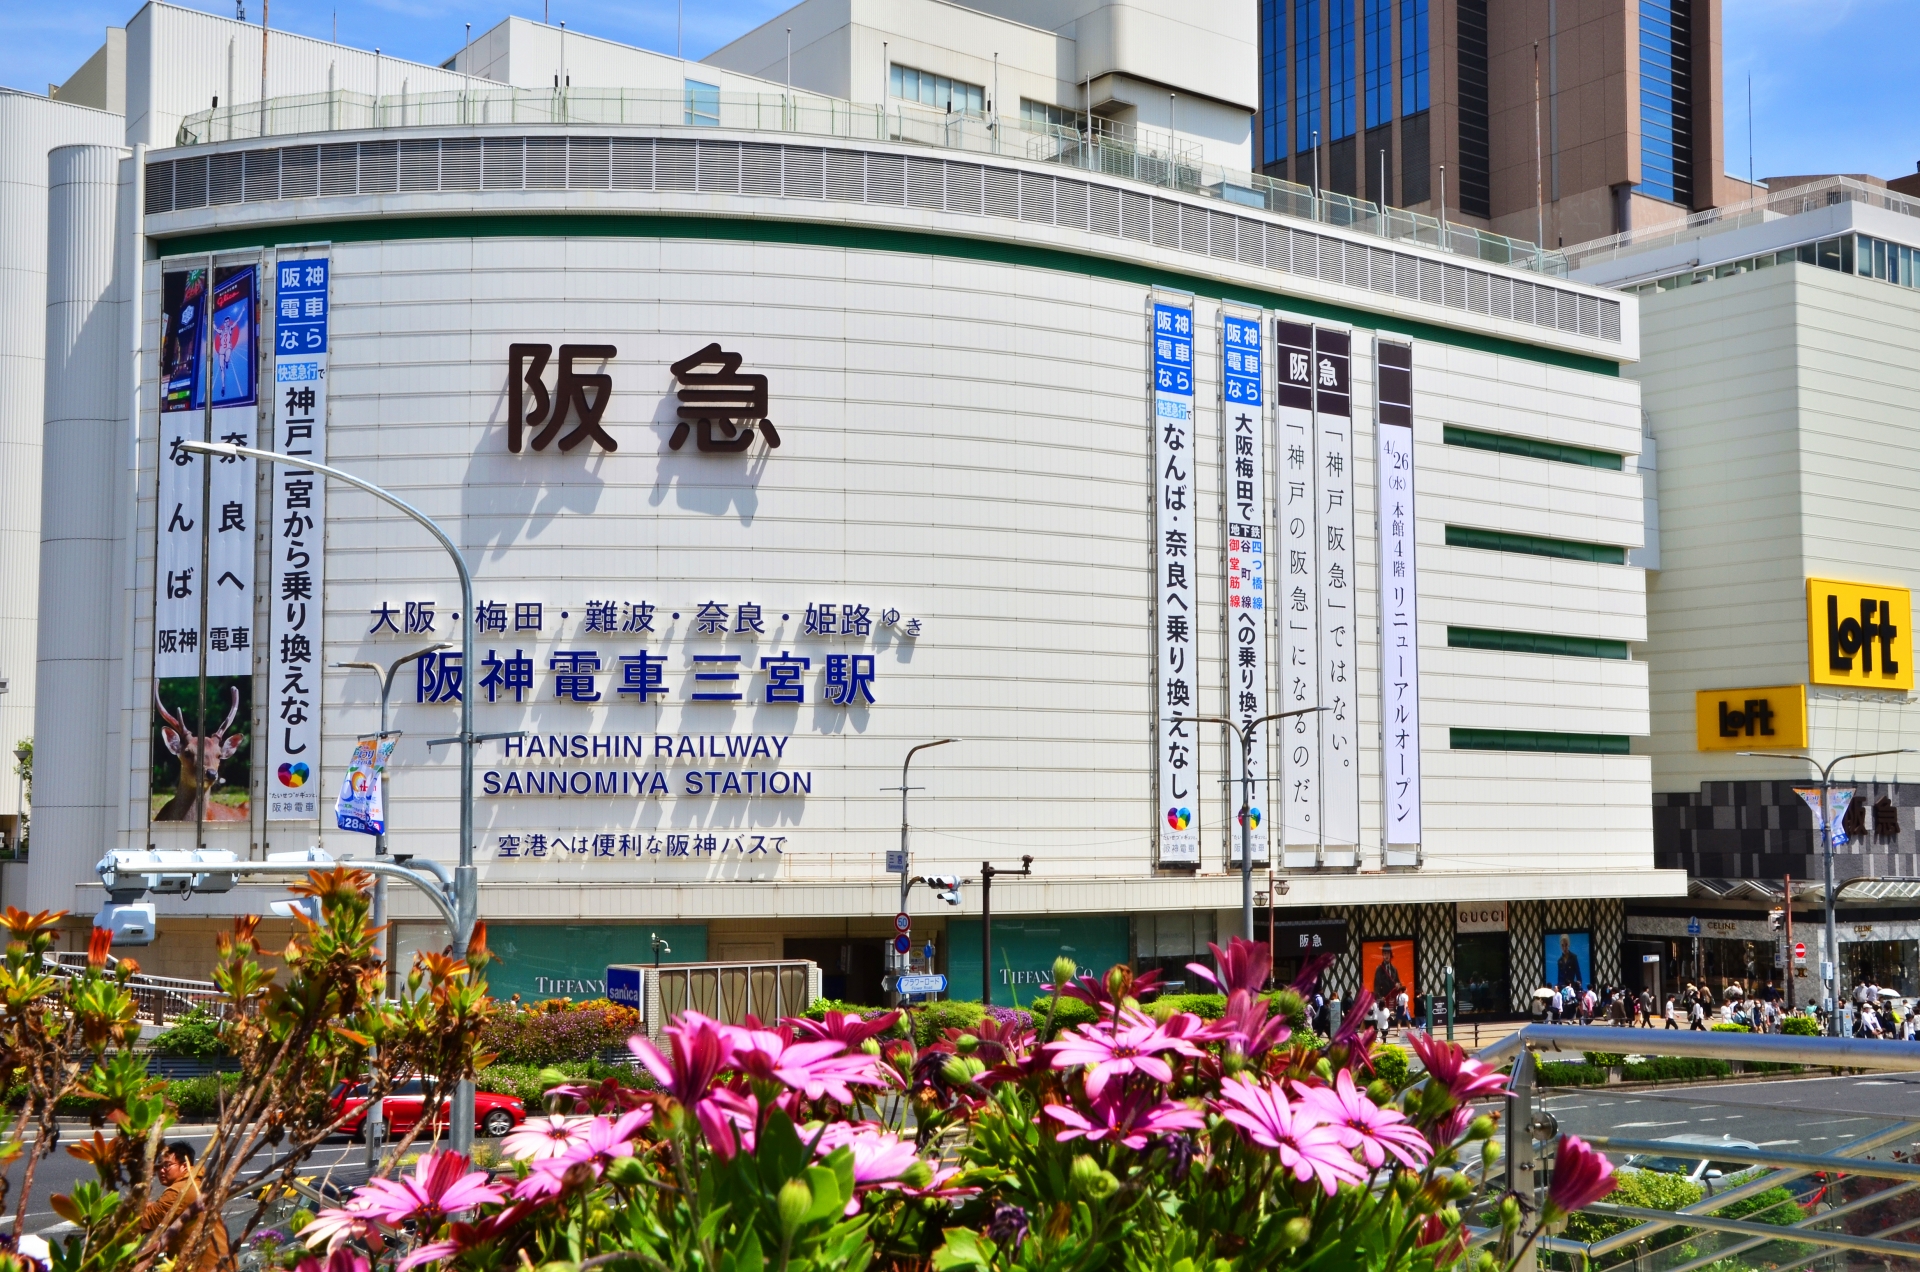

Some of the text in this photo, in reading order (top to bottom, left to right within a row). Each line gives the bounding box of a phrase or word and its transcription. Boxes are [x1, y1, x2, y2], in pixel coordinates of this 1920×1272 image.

[281, 266, 324, 288] 阪神
[281, 297, 324, 319] 電車
[1157, 310, 1189, 333] 阪神
[281, 328, 322, 350] なら
[1227, 322, 1258, 347] 阪神
[1157, 339, 1190, 362] 電車
[277, 363, 325, 382] 快速急行で
[1227, 351, 1259, 374] 電車
[1289, 352, 1338, 387] 阪急
[1158, 368, 1190, 391] なら
[1228, 380, 1259, 402] なら
[508, 342, 781, 454] 阪急
[1235, 413, 1255, 522] 大阪梅田で
[166, 436, 195, 599] なんば
[217, 432, 248, 591] 奈良へ
[1230, 524, 1260, 538] 地下鉄
[280, 386, 316, 755] 神戸三宮から乗り換えなし
[1229, 539, 1240, 608] 御堂筋線
[1241, 540, 1251, 608] 谷町線
[1252, 541, 1262, 610] 四つ橋線
[1325, 430, 1350, 768] 「神戸阪急」ではない。
[1164, 423, 1190, 800] なんば・奈良へ乗り換えなし
[1286, 424, 1311, 823] 「神戸の阪急」になるのだ。
[158, 626, 250, 654] 阪神 電車
[417, 649, 876, 705] 阪神電車三宮駅
[504, 735, 789, 758] HANSHIN RAILWAY
[483, 771, 812, 794] SANNOMIYA STATION
[272, 802, 314, 813] 阪神電車
[498, 832, 788, 858] 空港へは便利な阪神バスで
[897, 917, 908, 928] 50
[1460, 911, 1505, 923] GUCCI
[1708, 922, 1736, 930] CELINE
[1300, 934, 1322, 947] 阪急
[1854, 925, 1873, 933] CELINE
[535, 977, 607, 993] TIFFANY
[904, 978, 940, 987] フラワーロード
[1000, 969, 1054, 985] TIFFAN
[609, 984, 639, 1001] santica
